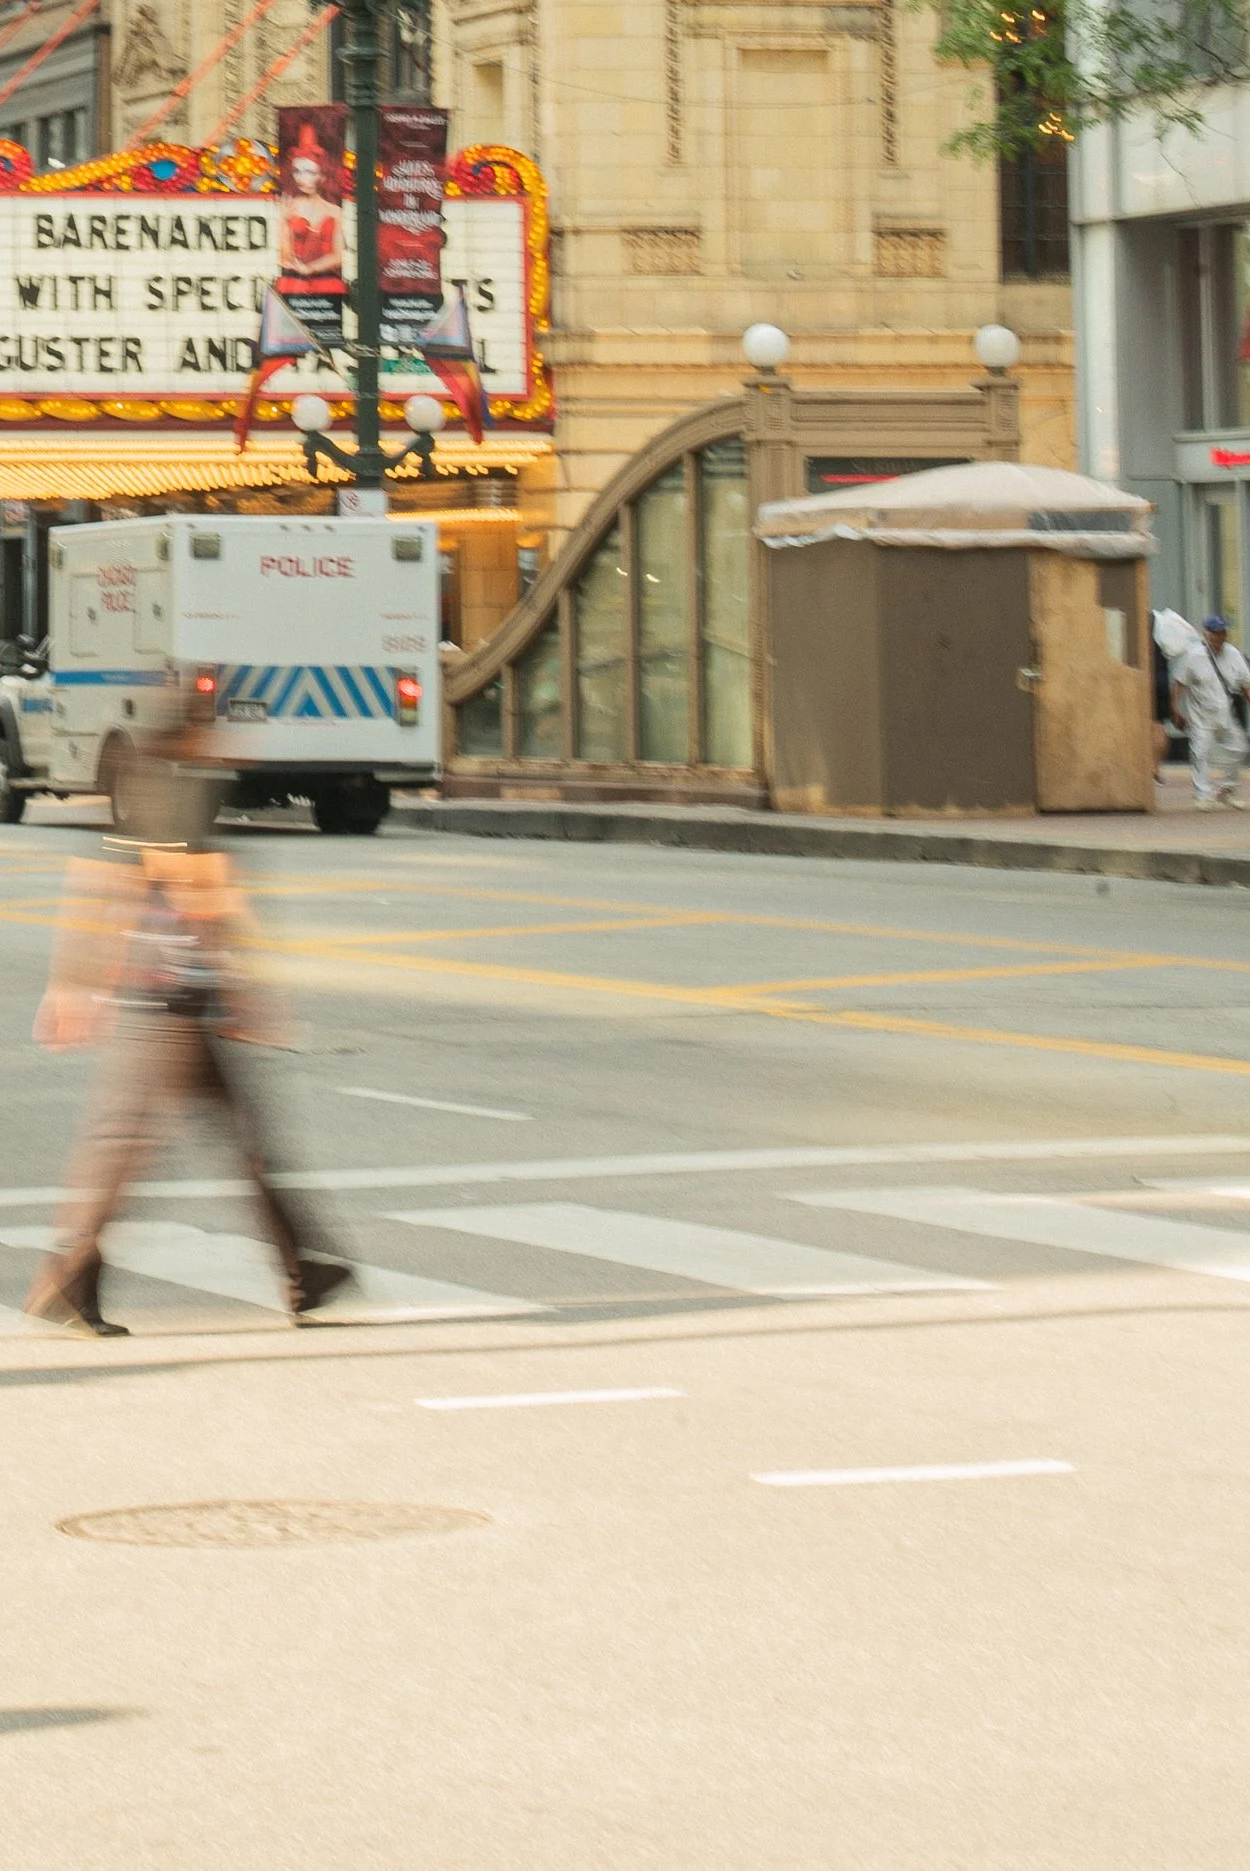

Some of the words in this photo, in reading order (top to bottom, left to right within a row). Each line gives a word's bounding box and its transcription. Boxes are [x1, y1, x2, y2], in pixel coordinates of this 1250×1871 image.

[35, 213, 267, 250] BARENAKED
[16, 275, 114, 312] WITH
[180, 336, 258, 372] AND
[260, 556, 356, 578] POLICE
